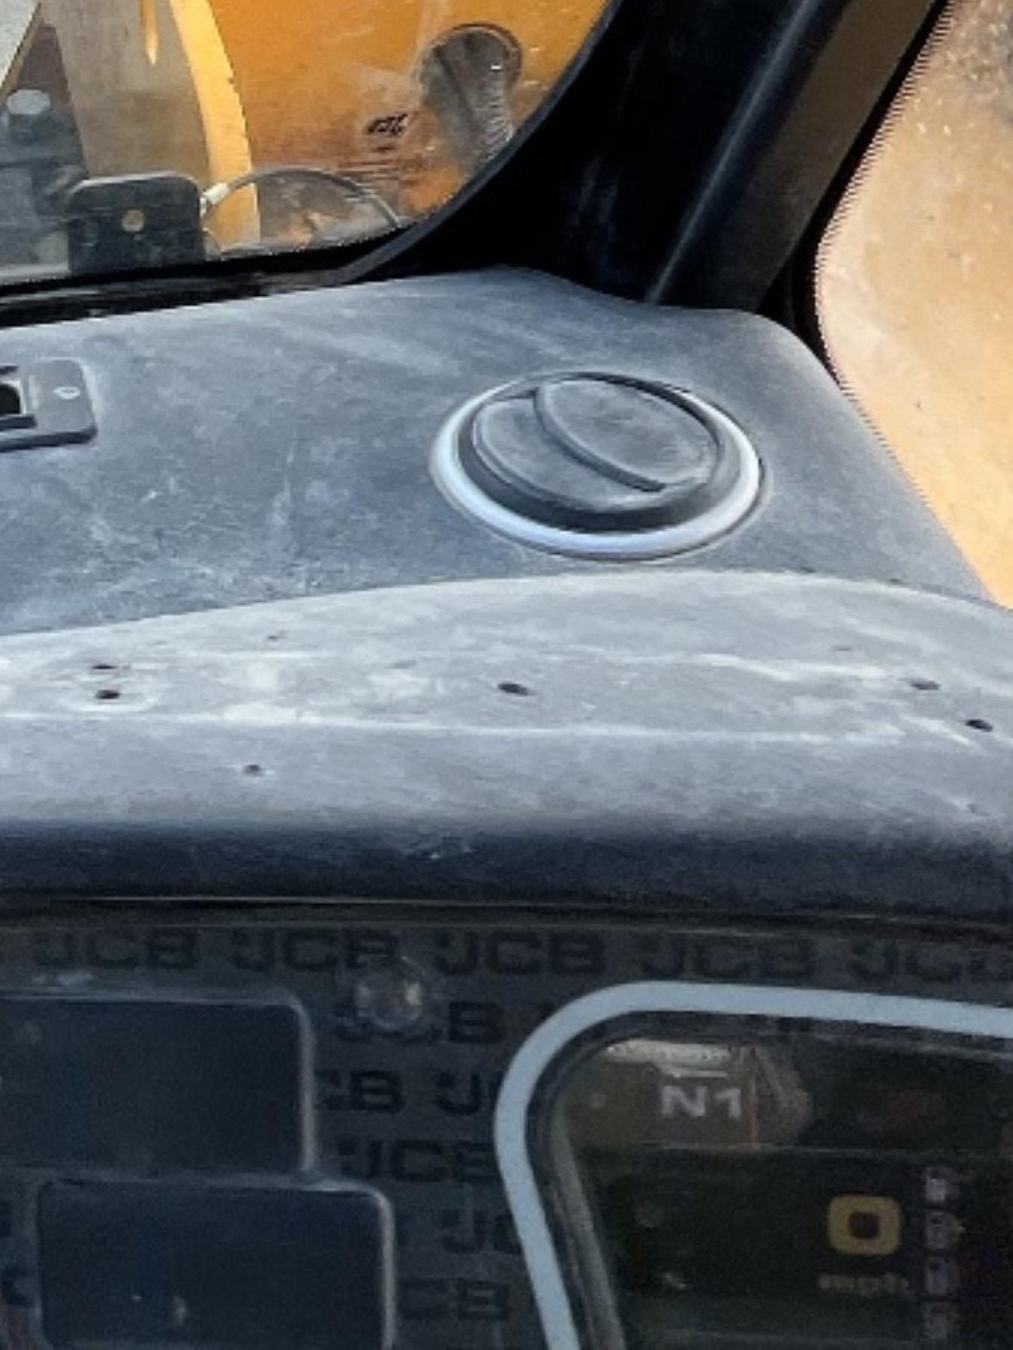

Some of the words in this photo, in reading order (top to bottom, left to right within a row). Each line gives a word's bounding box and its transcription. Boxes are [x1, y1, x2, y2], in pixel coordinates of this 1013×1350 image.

[433, 932, 605, 975] JCB
[638, 936, 817, 978] JCB
[659, 1084, 743, 1120] N1
